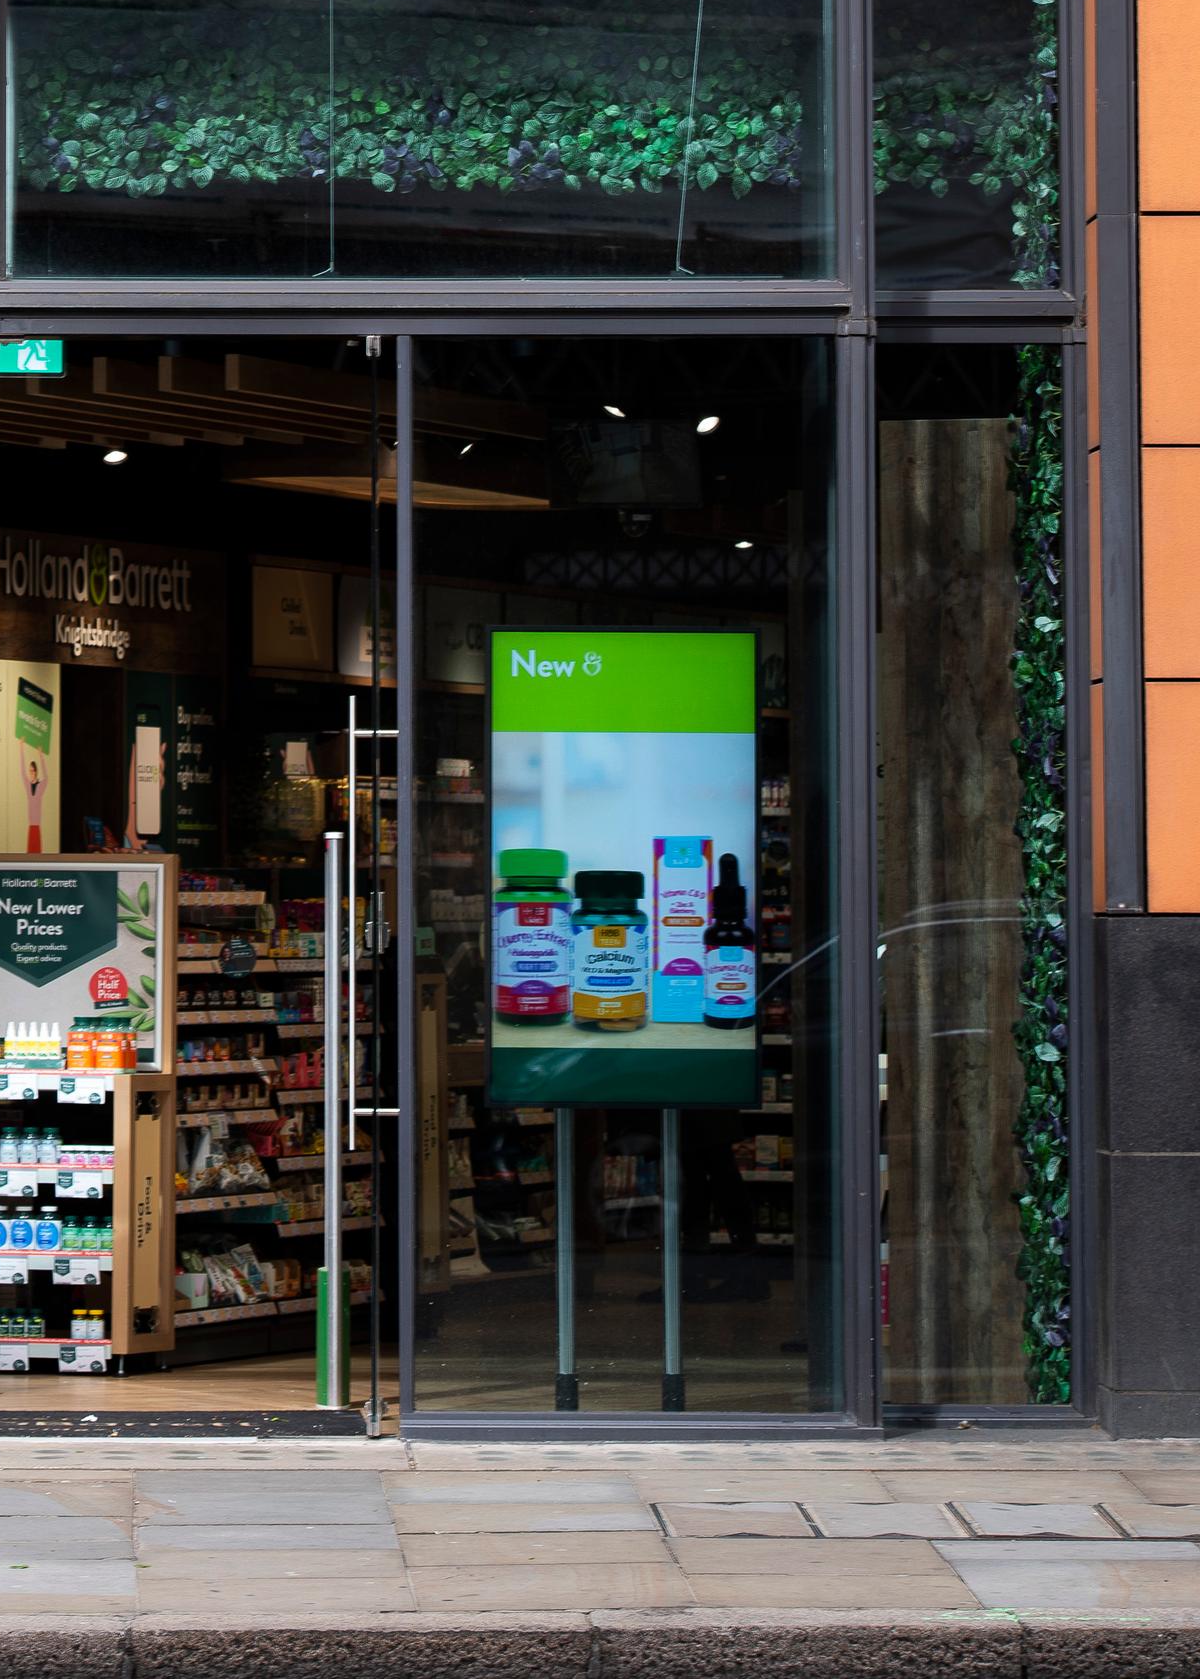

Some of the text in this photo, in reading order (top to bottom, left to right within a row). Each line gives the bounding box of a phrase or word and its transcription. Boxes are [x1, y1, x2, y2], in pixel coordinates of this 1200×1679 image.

[54, 613, 131, 660] Knightsbridge
[511, 648, 576, 678] New
[36, 897, 84, 915] Lower
[16, 918, 64, 936] Prices
[10, 942, 68, 953] Quality products
[16, 954, 63, 964] Expert advice
[585, 950, 635, 965] Calcium
[97, 979, 121, 990] Half
[97, 989, 121, 999] Price
[145, 1176, 153, 1215] Food
